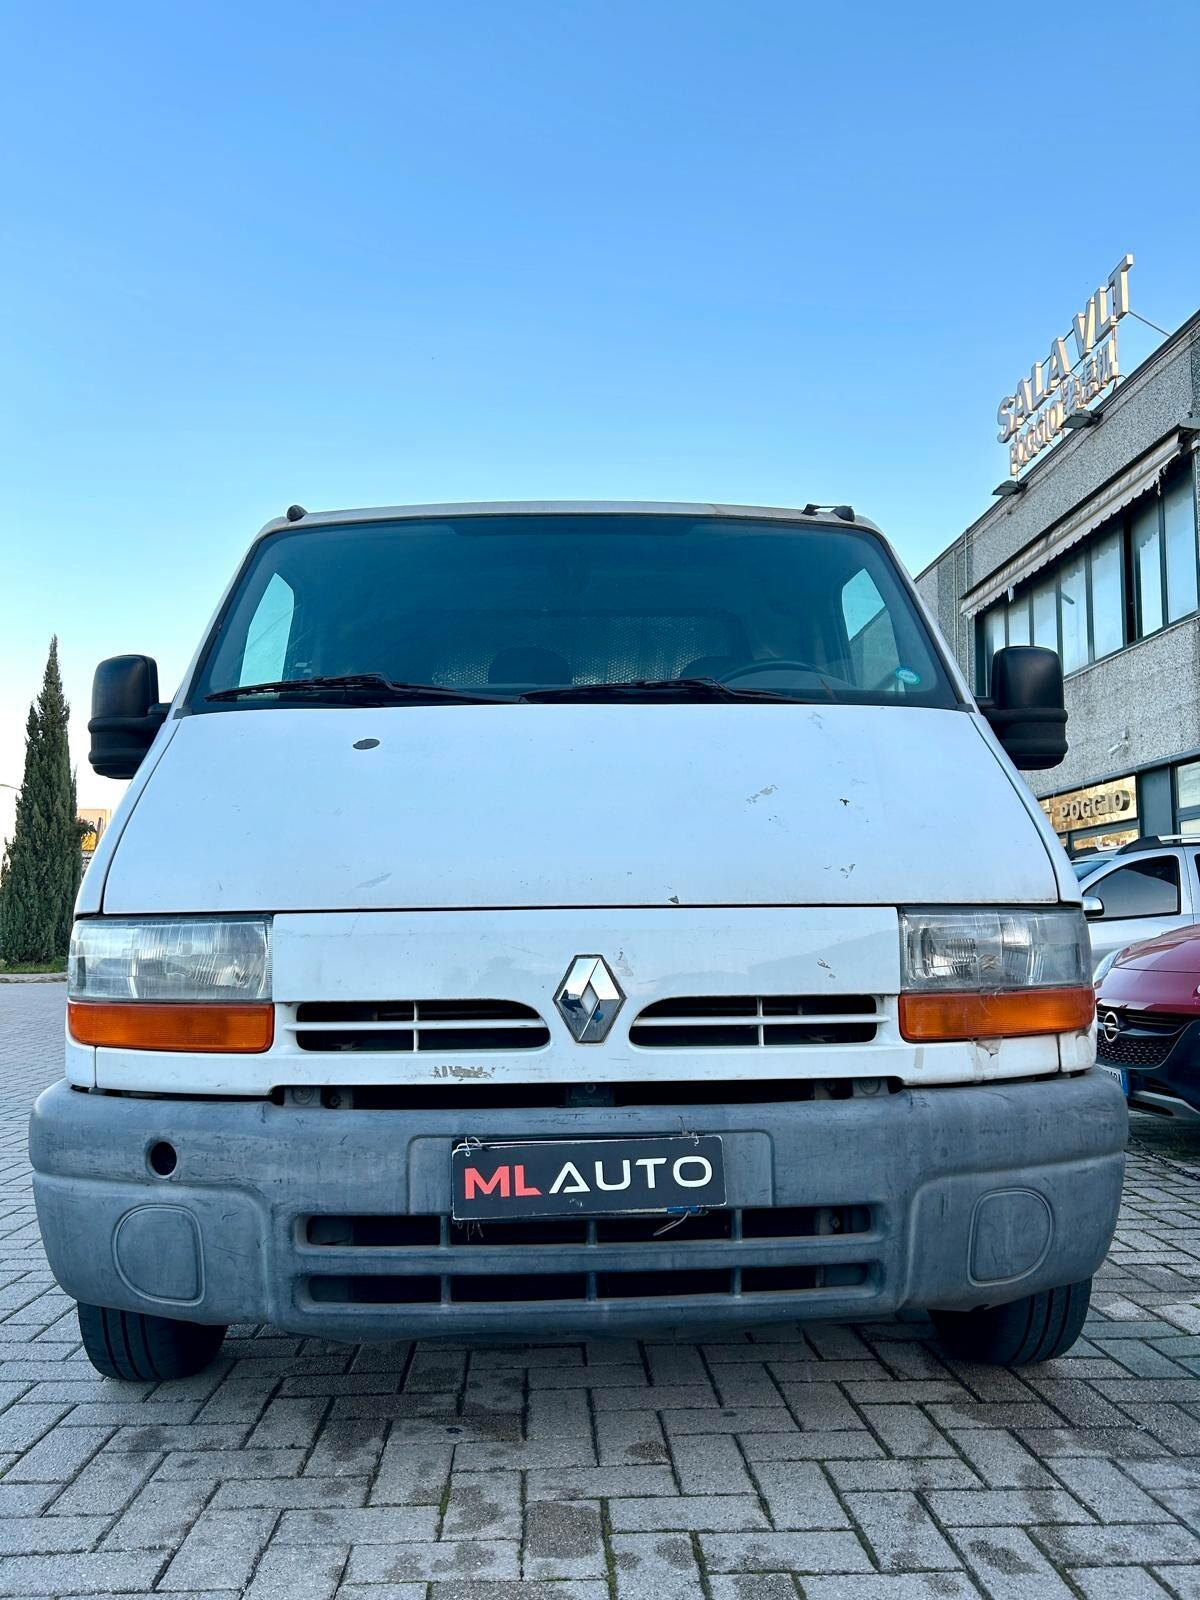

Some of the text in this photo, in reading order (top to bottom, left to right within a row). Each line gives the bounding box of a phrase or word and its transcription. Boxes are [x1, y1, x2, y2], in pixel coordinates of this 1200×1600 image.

[997, 254, 1134, 443] SALA VLT
[1060, 790, 1129, 820] POGGIO
[464, 1156, 713, 1200] ML AUTO
